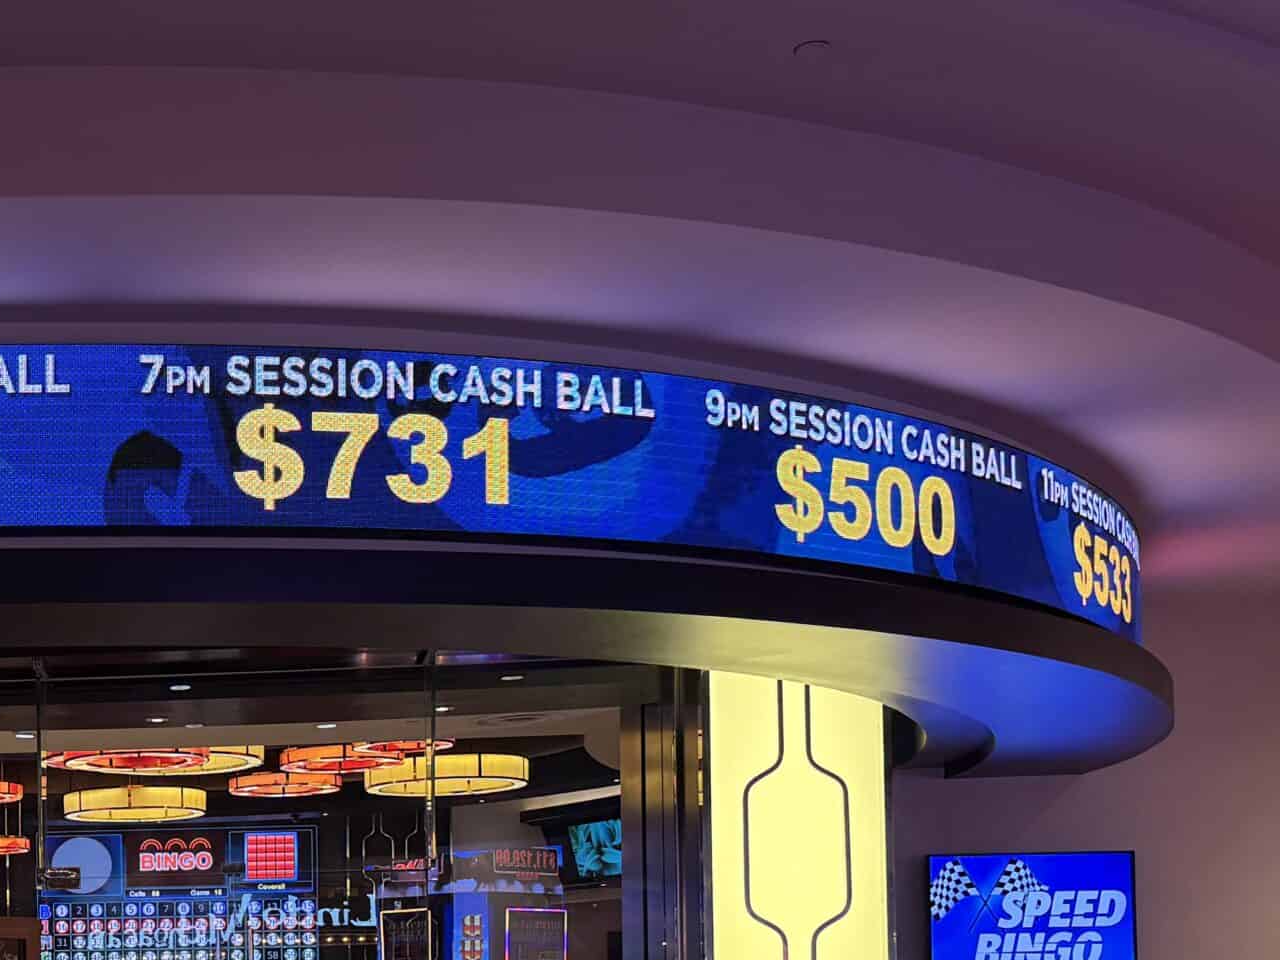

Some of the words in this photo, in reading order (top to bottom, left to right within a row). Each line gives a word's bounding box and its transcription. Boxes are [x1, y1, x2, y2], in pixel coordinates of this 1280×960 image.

[138, 354, 210, 395] 7PM
[225, 355, 414, 400] SESSION
[428, 362, 543, 409] CASH
[556, 371, 655, 418] BALL
[232, 402, 510, 510] $731
[704, 388, 760, 431] 9PM
[769, 398, 894, 456] SESSION
[901, 424, 966, 473] CASH
[972, 442, 1022, 490] BALL
[774, 444, 956, 556] $500
[1041, 468, 1069, 509] 11PM
[1071, 481, 1116, 537] SESSION
[1073, 521, 1133, 624] $533
[139, 852, 213, 872] BINGO
[998, 889, 1127, 929] SPEED
